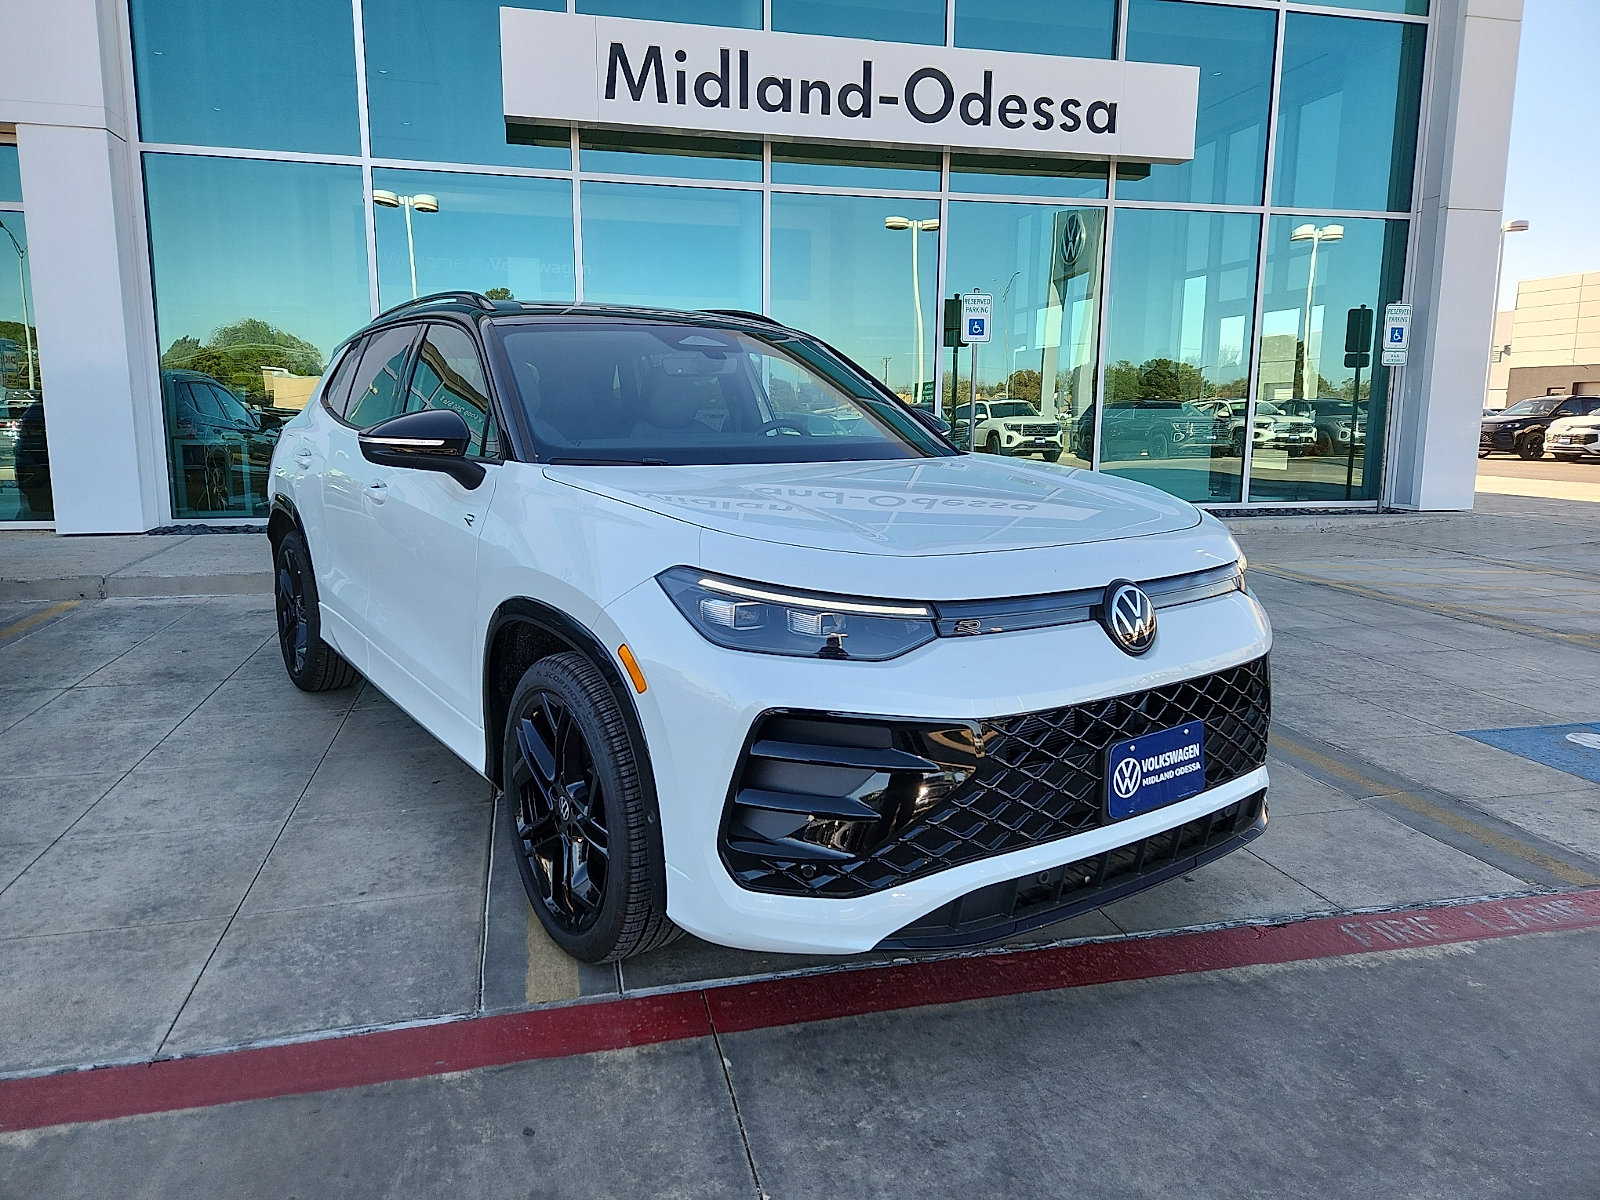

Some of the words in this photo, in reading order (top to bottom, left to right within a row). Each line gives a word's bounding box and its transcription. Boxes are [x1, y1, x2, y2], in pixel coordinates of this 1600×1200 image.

[605, 41, 1117, 134] Midland-Odessa
[1141, 743, 1200, 773] VOLKSWAGEN
[1142, 770, 1174, 786] MIDLAND
[1175, 762, 1201, 776] ODESSA
[1340, 915, 1447, 948] FIRE
